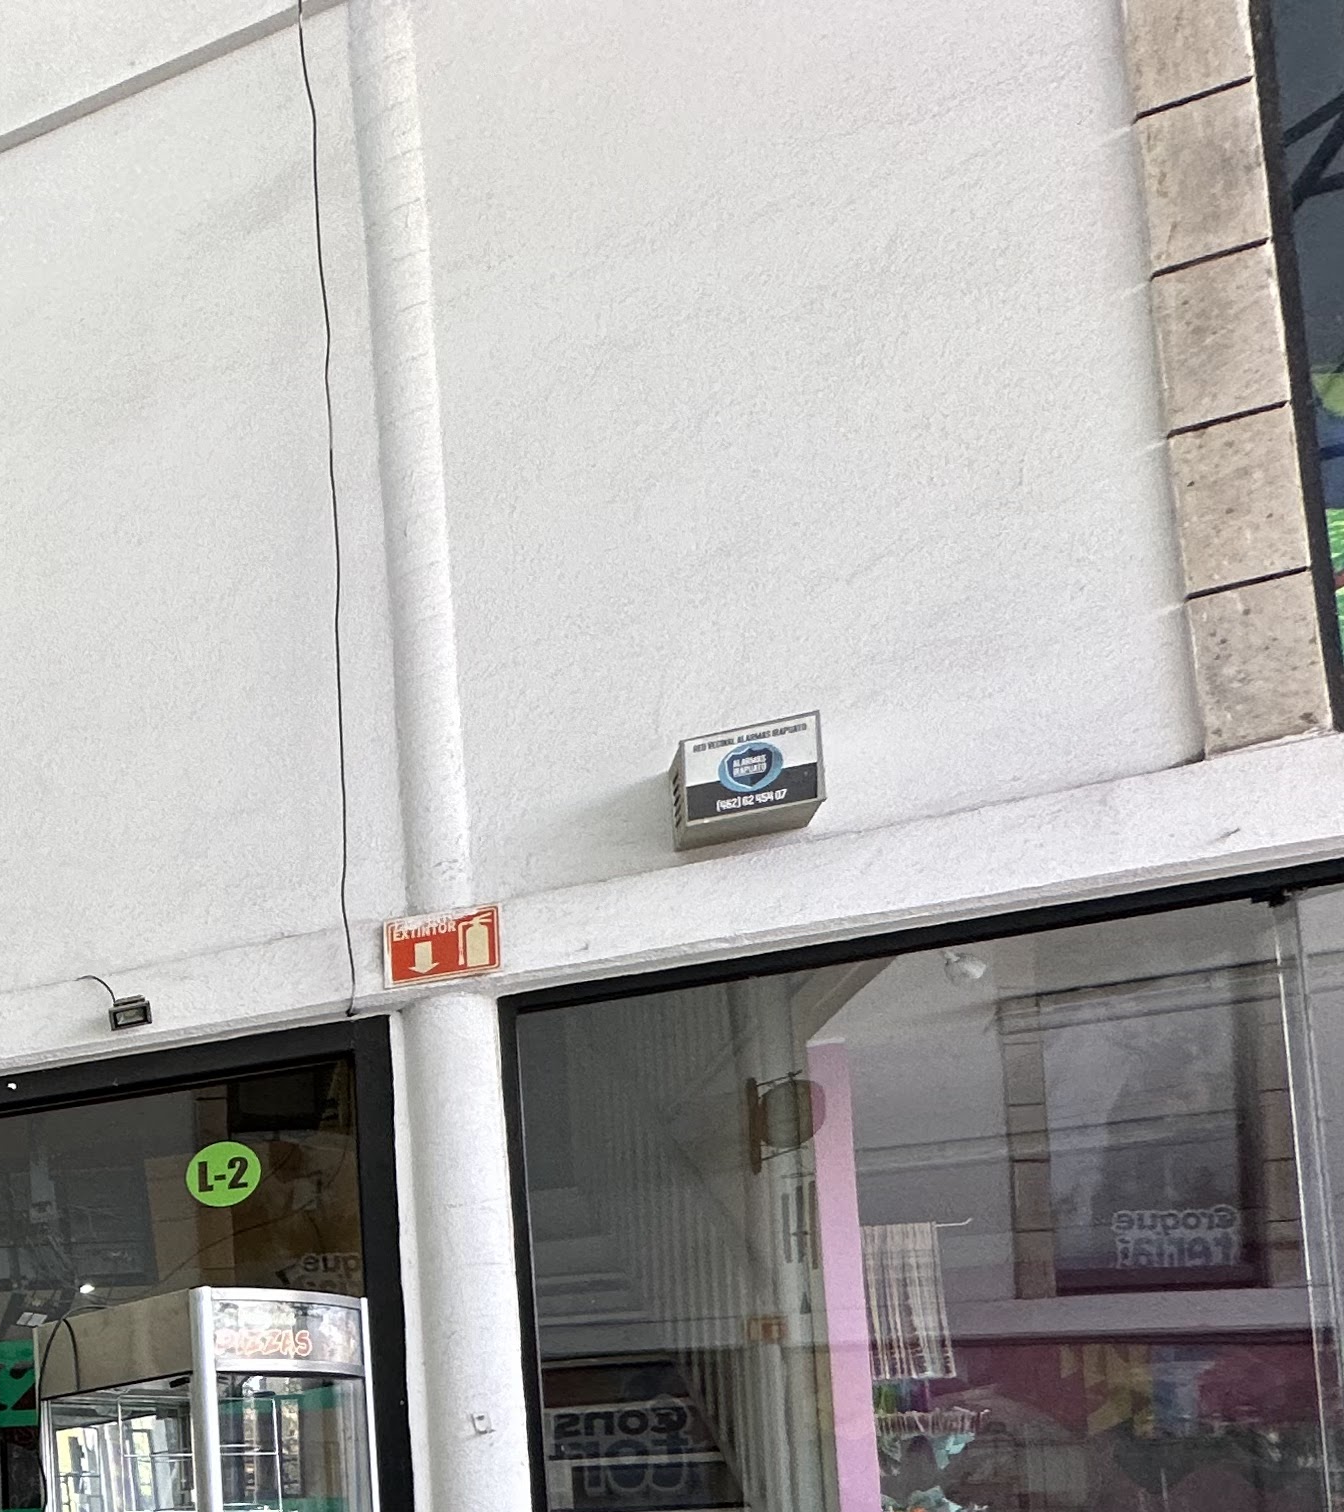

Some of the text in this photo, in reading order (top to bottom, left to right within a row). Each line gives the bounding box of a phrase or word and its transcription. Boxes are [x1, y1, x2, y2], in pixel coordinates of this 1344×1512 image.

[737, 730, 771, 745] ALARMAS
[772, 722, 808, 737] IRAPUATO
[733, 754, 767, 768] ALARMAS
[733, 762, 767, 778] IRAPUATO
[393, 920, 457, 941] EXTINTOR
[198, 1156, 249, 1193] L-2
[214, 1328, 313, 1359] PIZZAS
